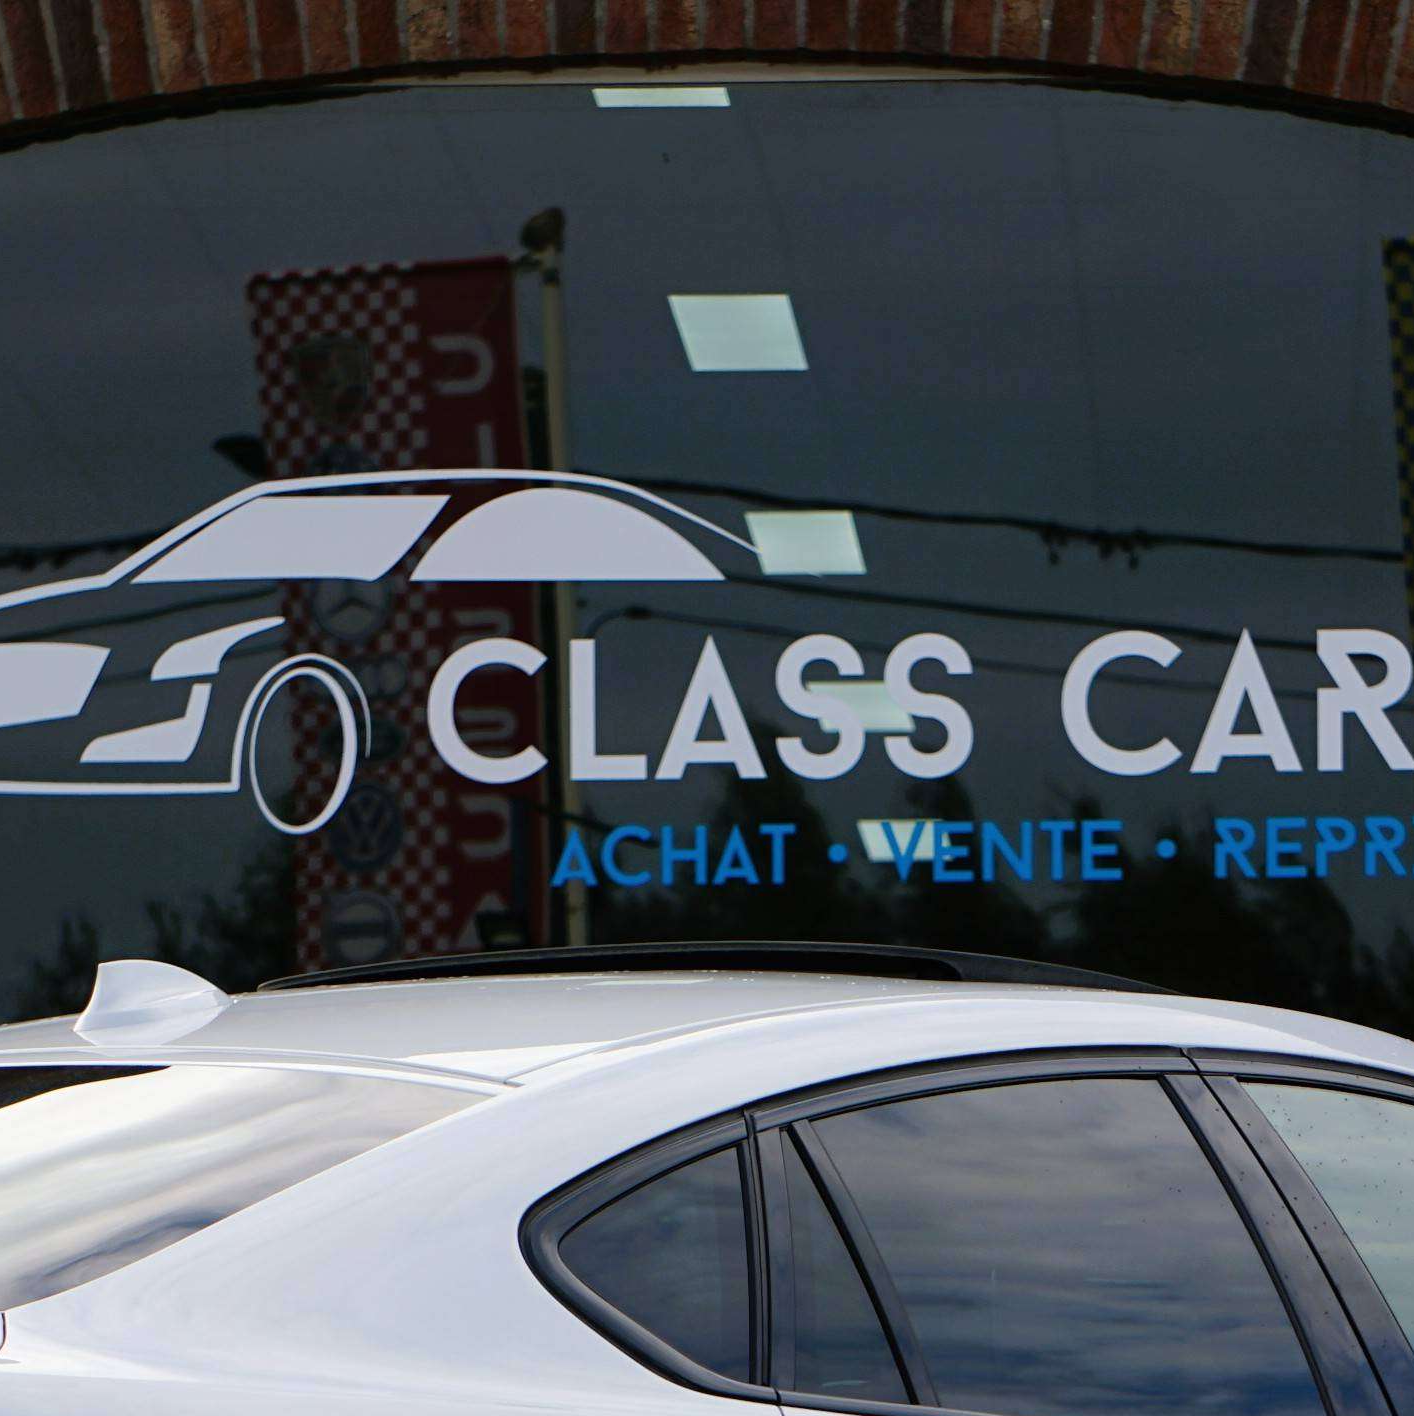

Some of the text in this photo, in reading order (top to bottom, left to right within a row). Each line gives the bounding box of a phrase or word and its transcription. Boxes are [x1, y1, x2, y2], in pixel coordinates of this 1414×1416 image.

[427, 632, 974, 784] CLASS
[552, 824, 796, 888] ACHAT
[881, 819, 1123, 883] VENTE
